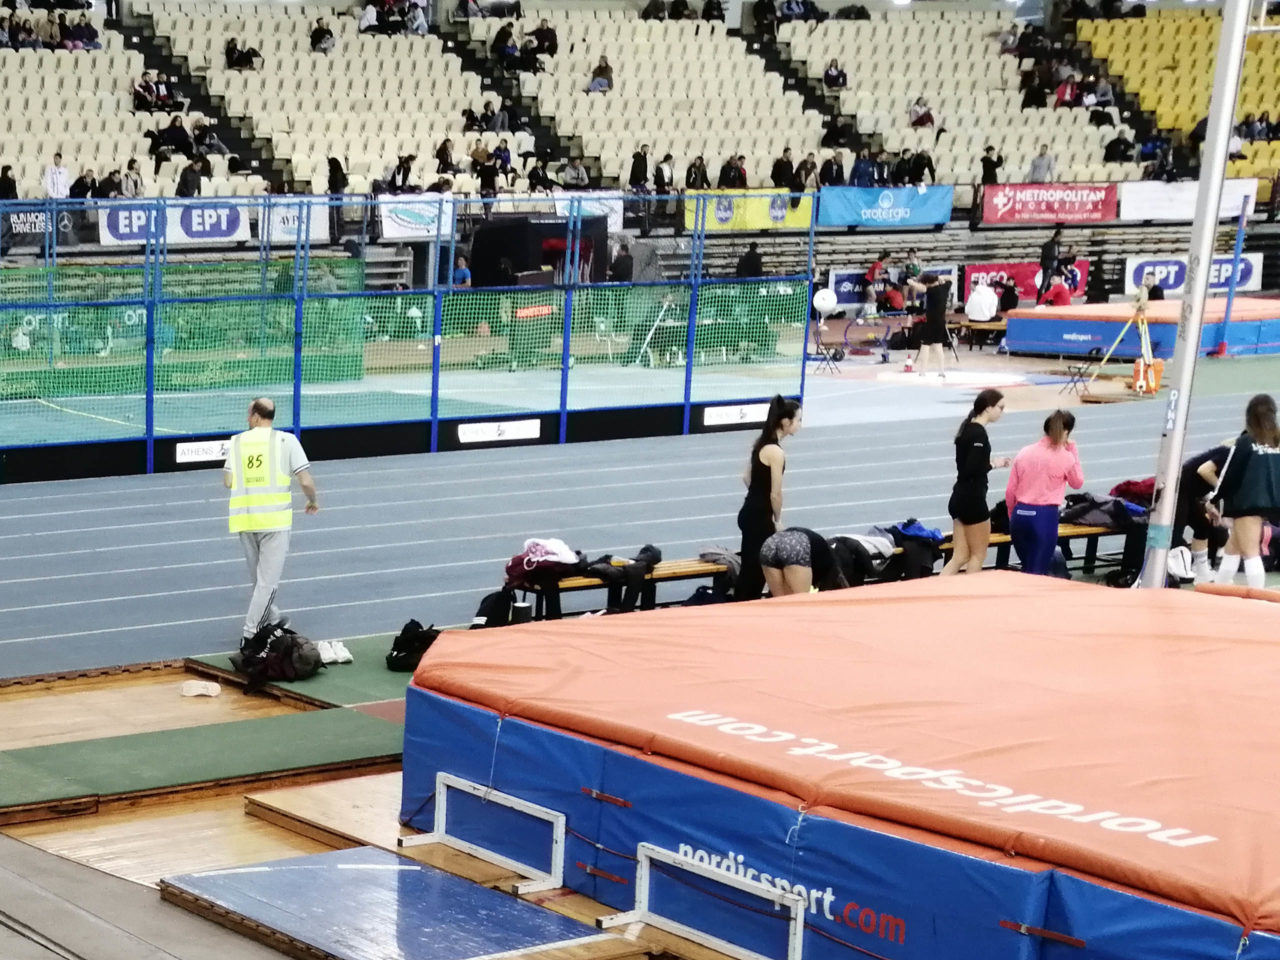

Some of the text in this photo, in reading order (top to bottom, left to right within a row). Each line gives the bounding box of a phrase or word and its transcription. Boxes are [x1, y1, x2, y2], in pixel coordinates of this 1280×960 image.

[1015, 189, 1106, 202] METROPOLITAN
[1015, 201, 1102, 210] HOSPITAL
[10, 214, 27, 224] RUN
[1166, 389, 1179, 430] DIMA
[180, 446, 214, 457] ATHENS
[246, 454, 263, 469] 85
[666, 709, 1219, 848] nordicsport.com
